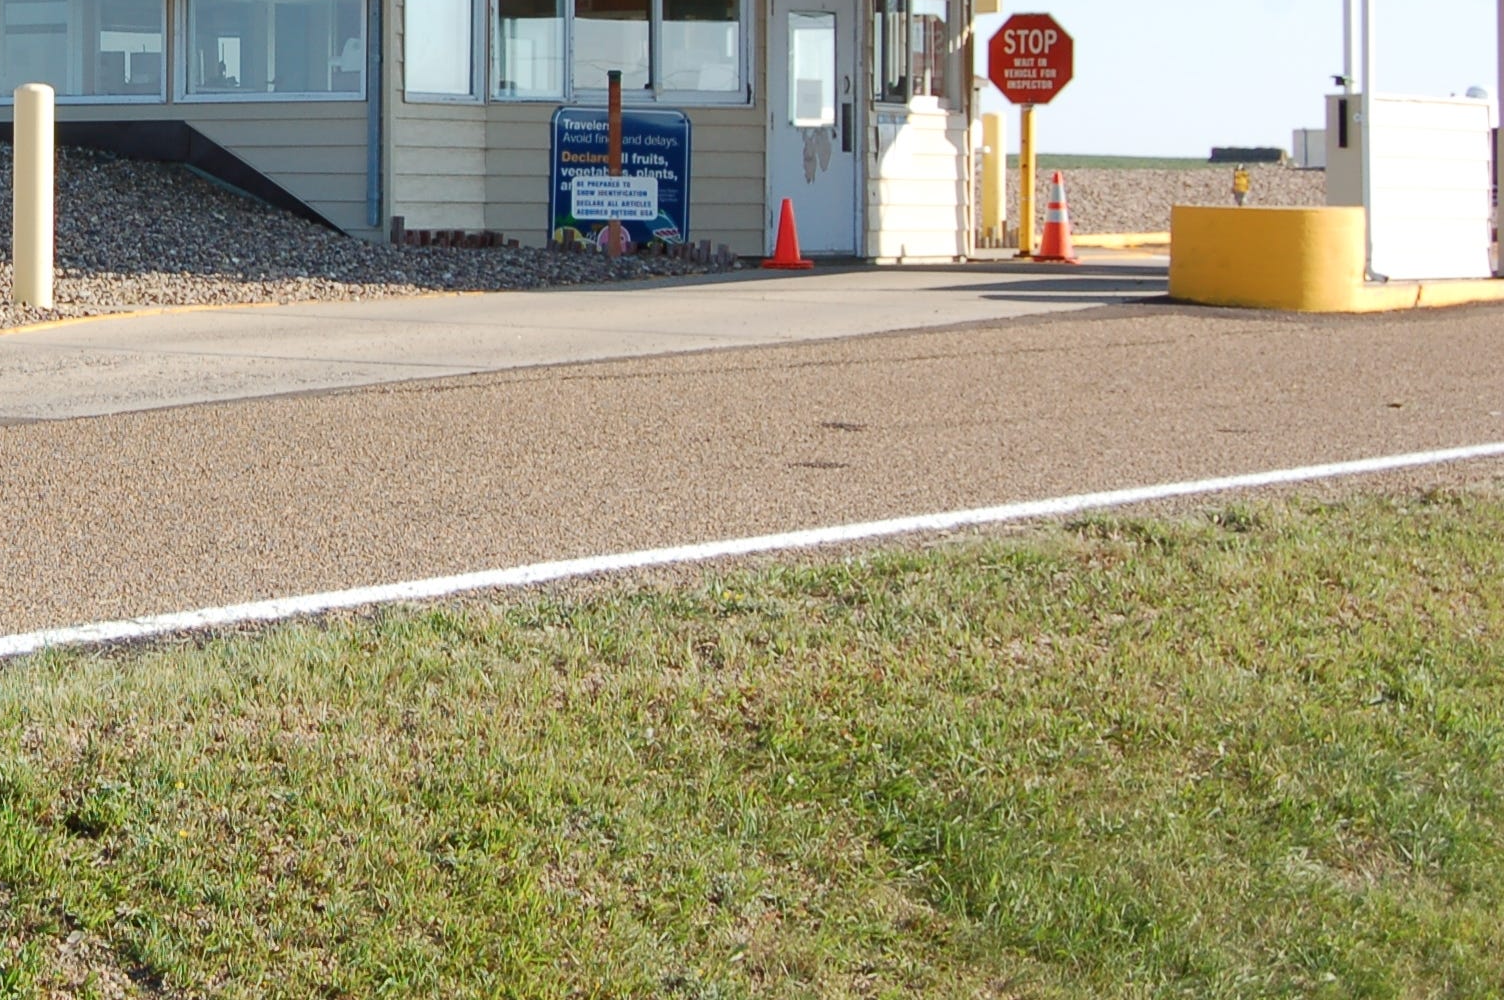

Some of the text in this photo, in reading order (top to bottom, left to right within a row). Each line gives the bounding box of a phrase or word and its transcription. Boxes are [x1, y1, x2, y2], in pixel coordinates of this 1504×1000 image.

[1003, 29, 1058, 54] STOP
[1013, 58, 1035, 67] WAIT
[1004, 69, 1037, 78] VEHICLE
[563, 132, 592, 143] Avoid
[622, 135, 642, 145] and
[632, 152, 668, 167] fruits,
